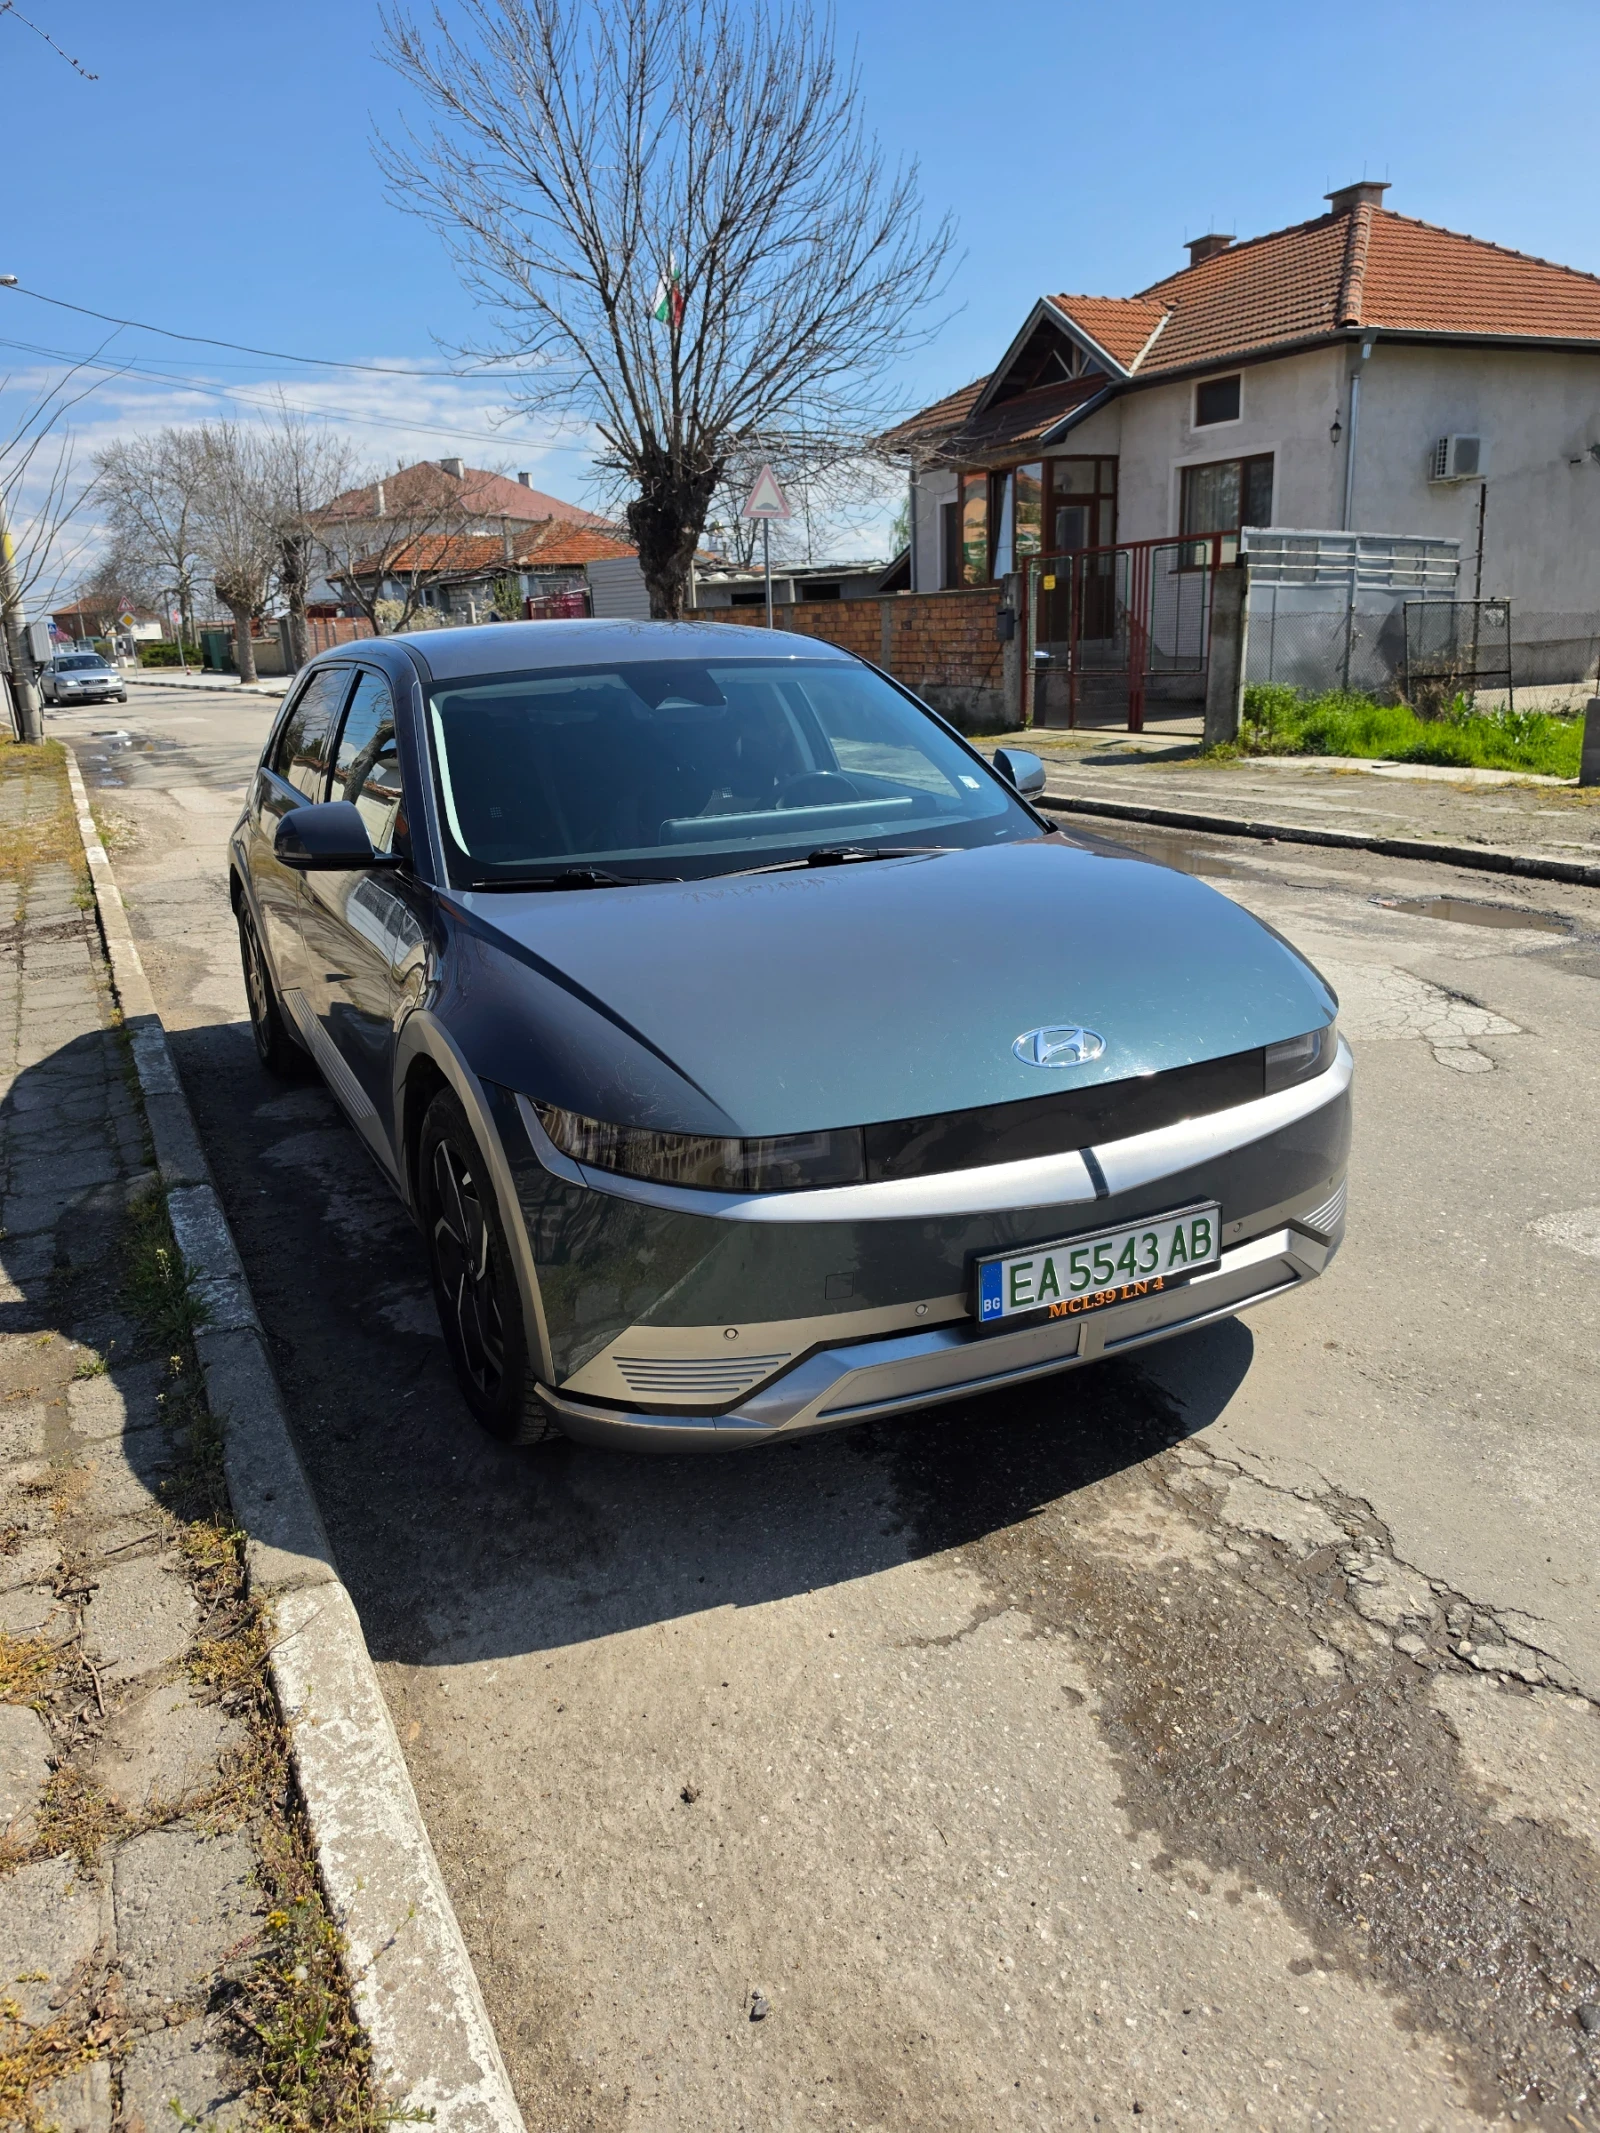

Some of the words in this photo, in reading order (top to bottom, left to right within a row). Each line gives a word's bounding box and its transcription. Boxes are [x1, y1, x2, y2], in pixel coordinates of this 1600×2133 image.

[1010, 1257, 1061, 1308] EA
[1070, 1232, 1159, 1292] 5543
[1168, 1218, 1212, 1267] AB
[983, 1297, 1001, 1313] BG
[1048, 1289, 1117, 1319] MCL39
[1121, 1280, 1148, 1299] LN
[1152, 1276, 1164, 1291] 4
